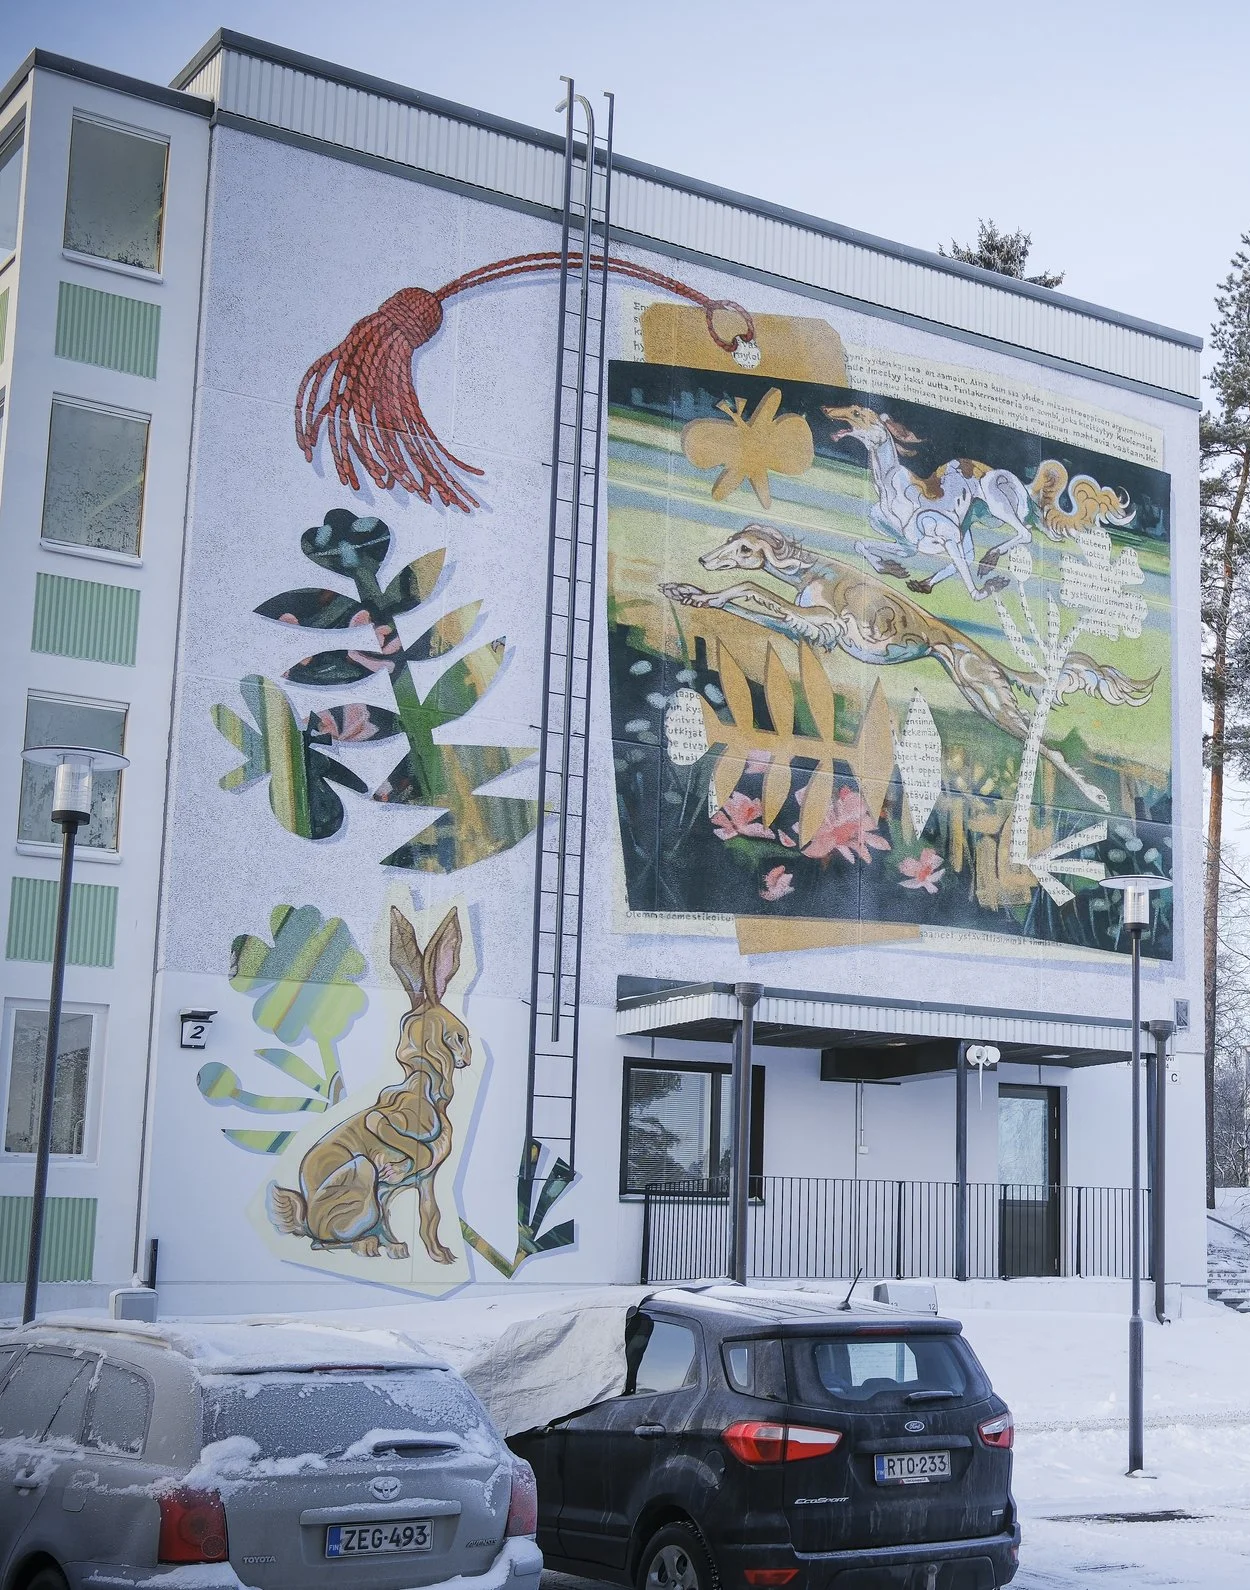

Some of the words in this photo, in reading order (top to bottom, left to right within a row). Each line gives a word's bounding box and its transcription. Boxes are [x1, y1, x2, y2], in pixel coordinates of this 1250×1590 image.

[190, 1025, 205, 1039] 2
[887, 1455, 947, 1475] RTO-233
[344, 1525, 427, 1551] ZEG-493
[243, 1556, 276, 1564] TOYOTA
